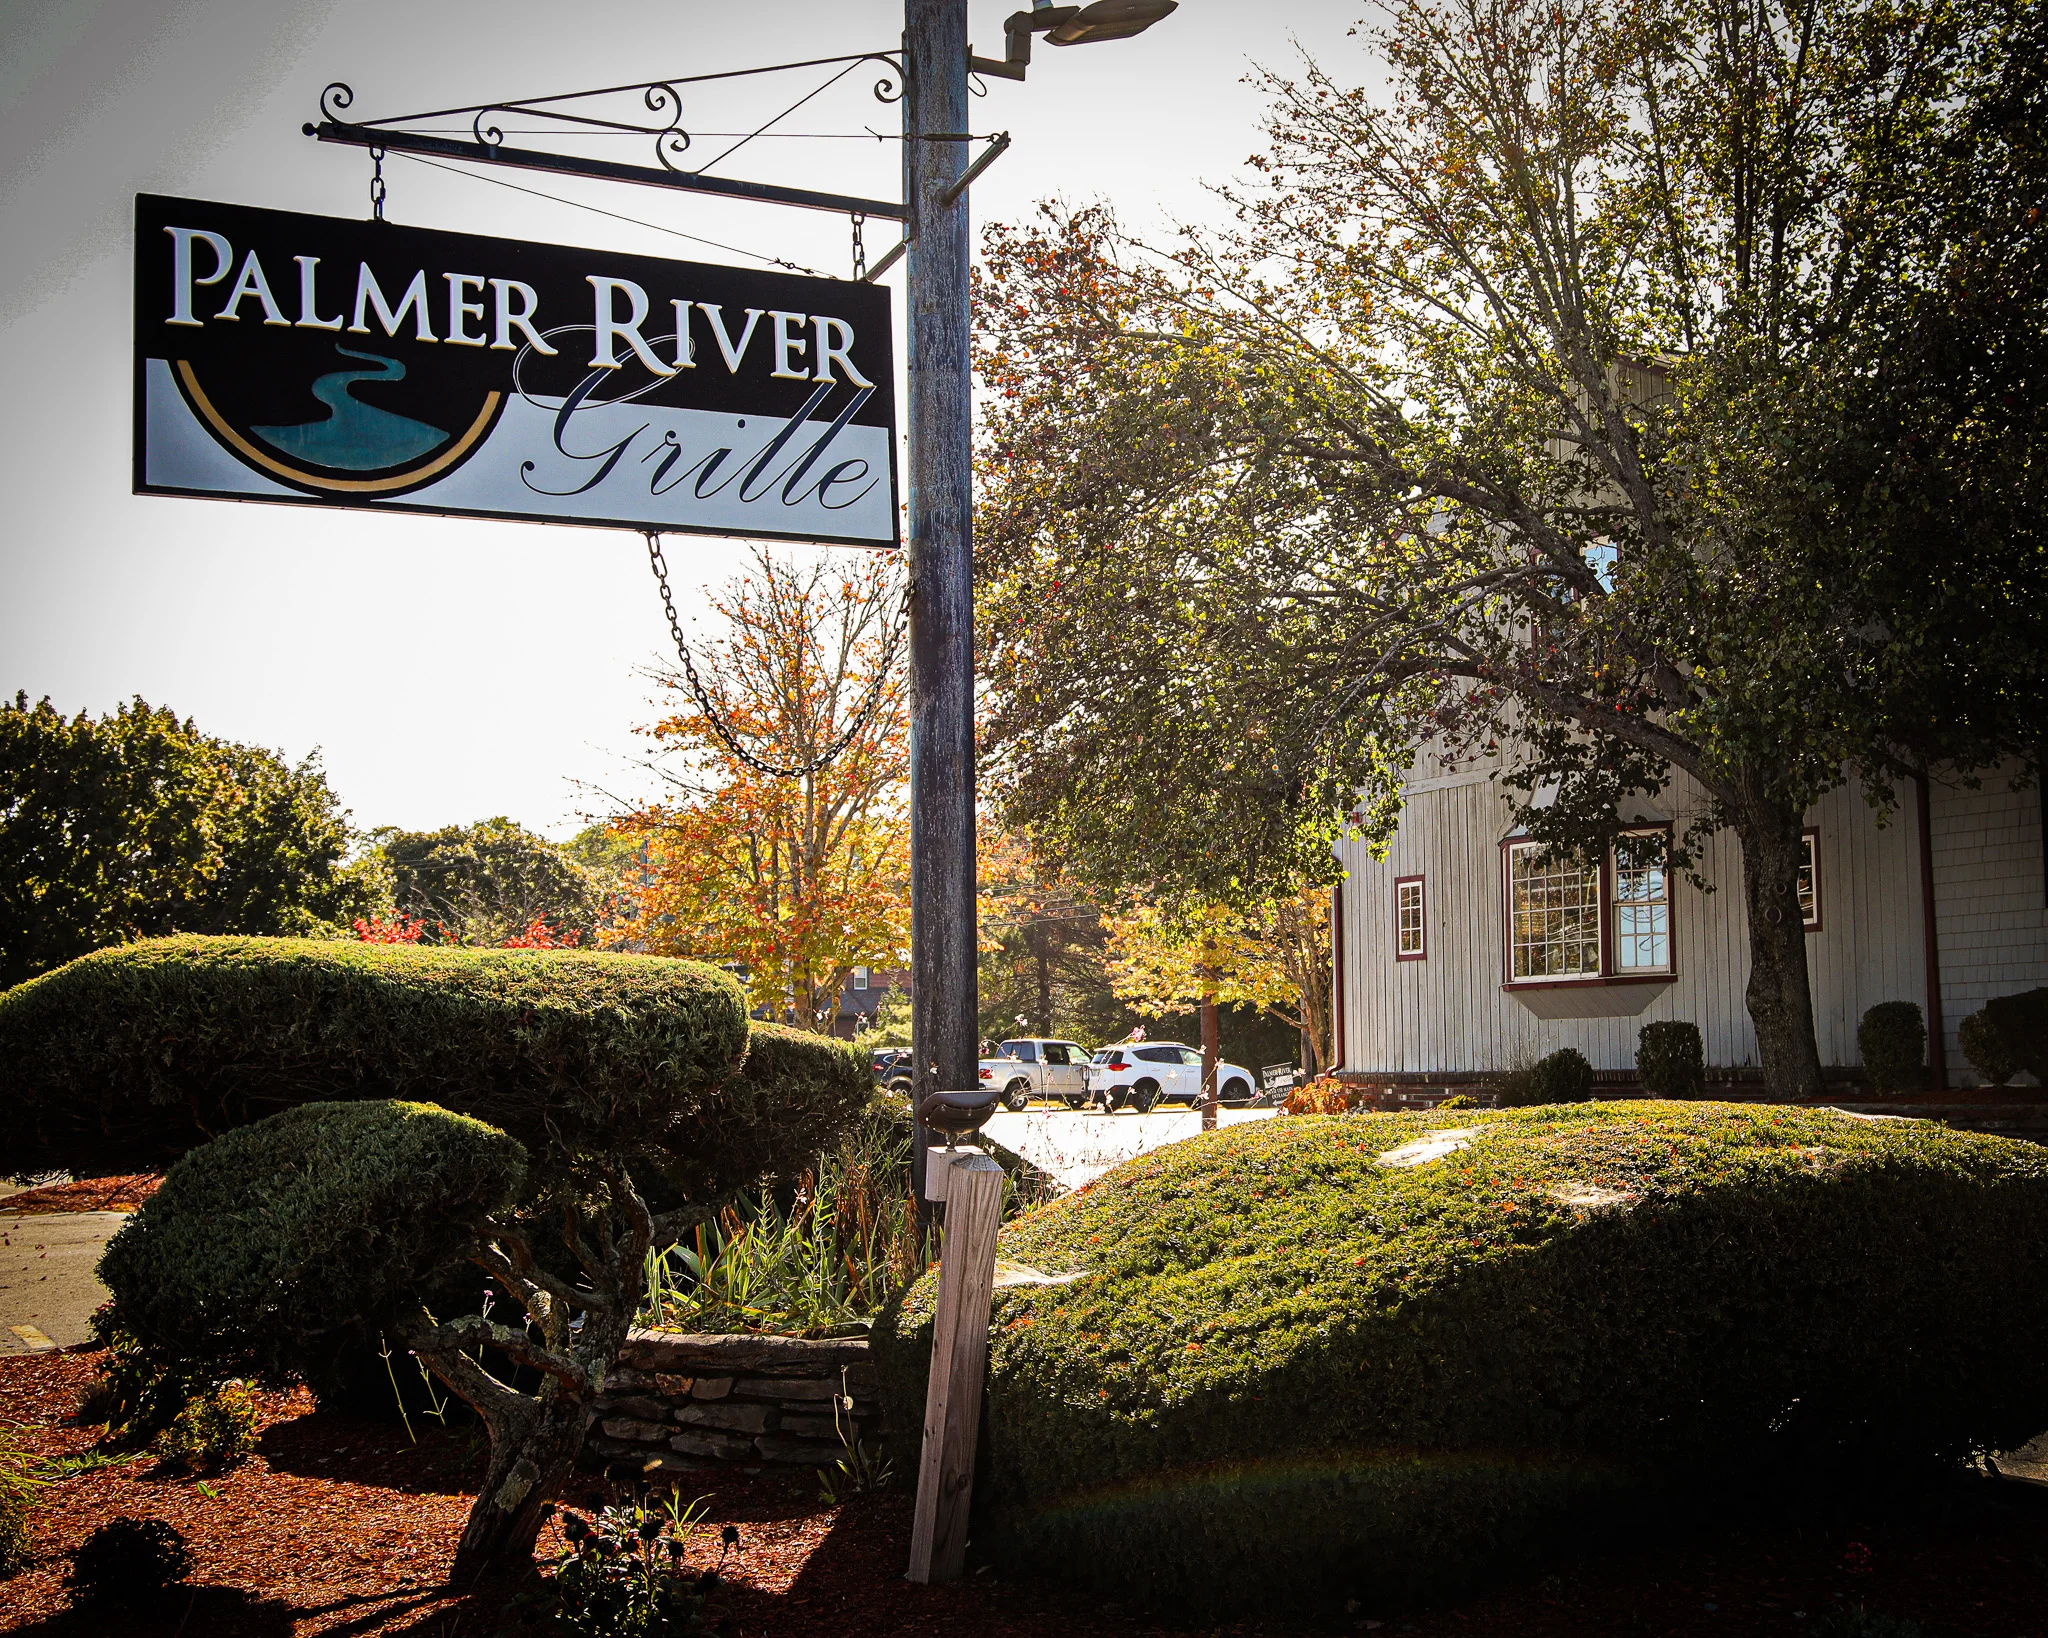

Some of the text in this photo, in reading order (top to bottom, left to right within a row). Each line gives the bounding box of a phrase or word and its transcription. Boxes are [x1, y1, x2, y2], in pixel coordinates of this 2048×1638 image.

[163, 226, 876, 388] PALMER RIVER
[512, 324, 880, 510] Grille
